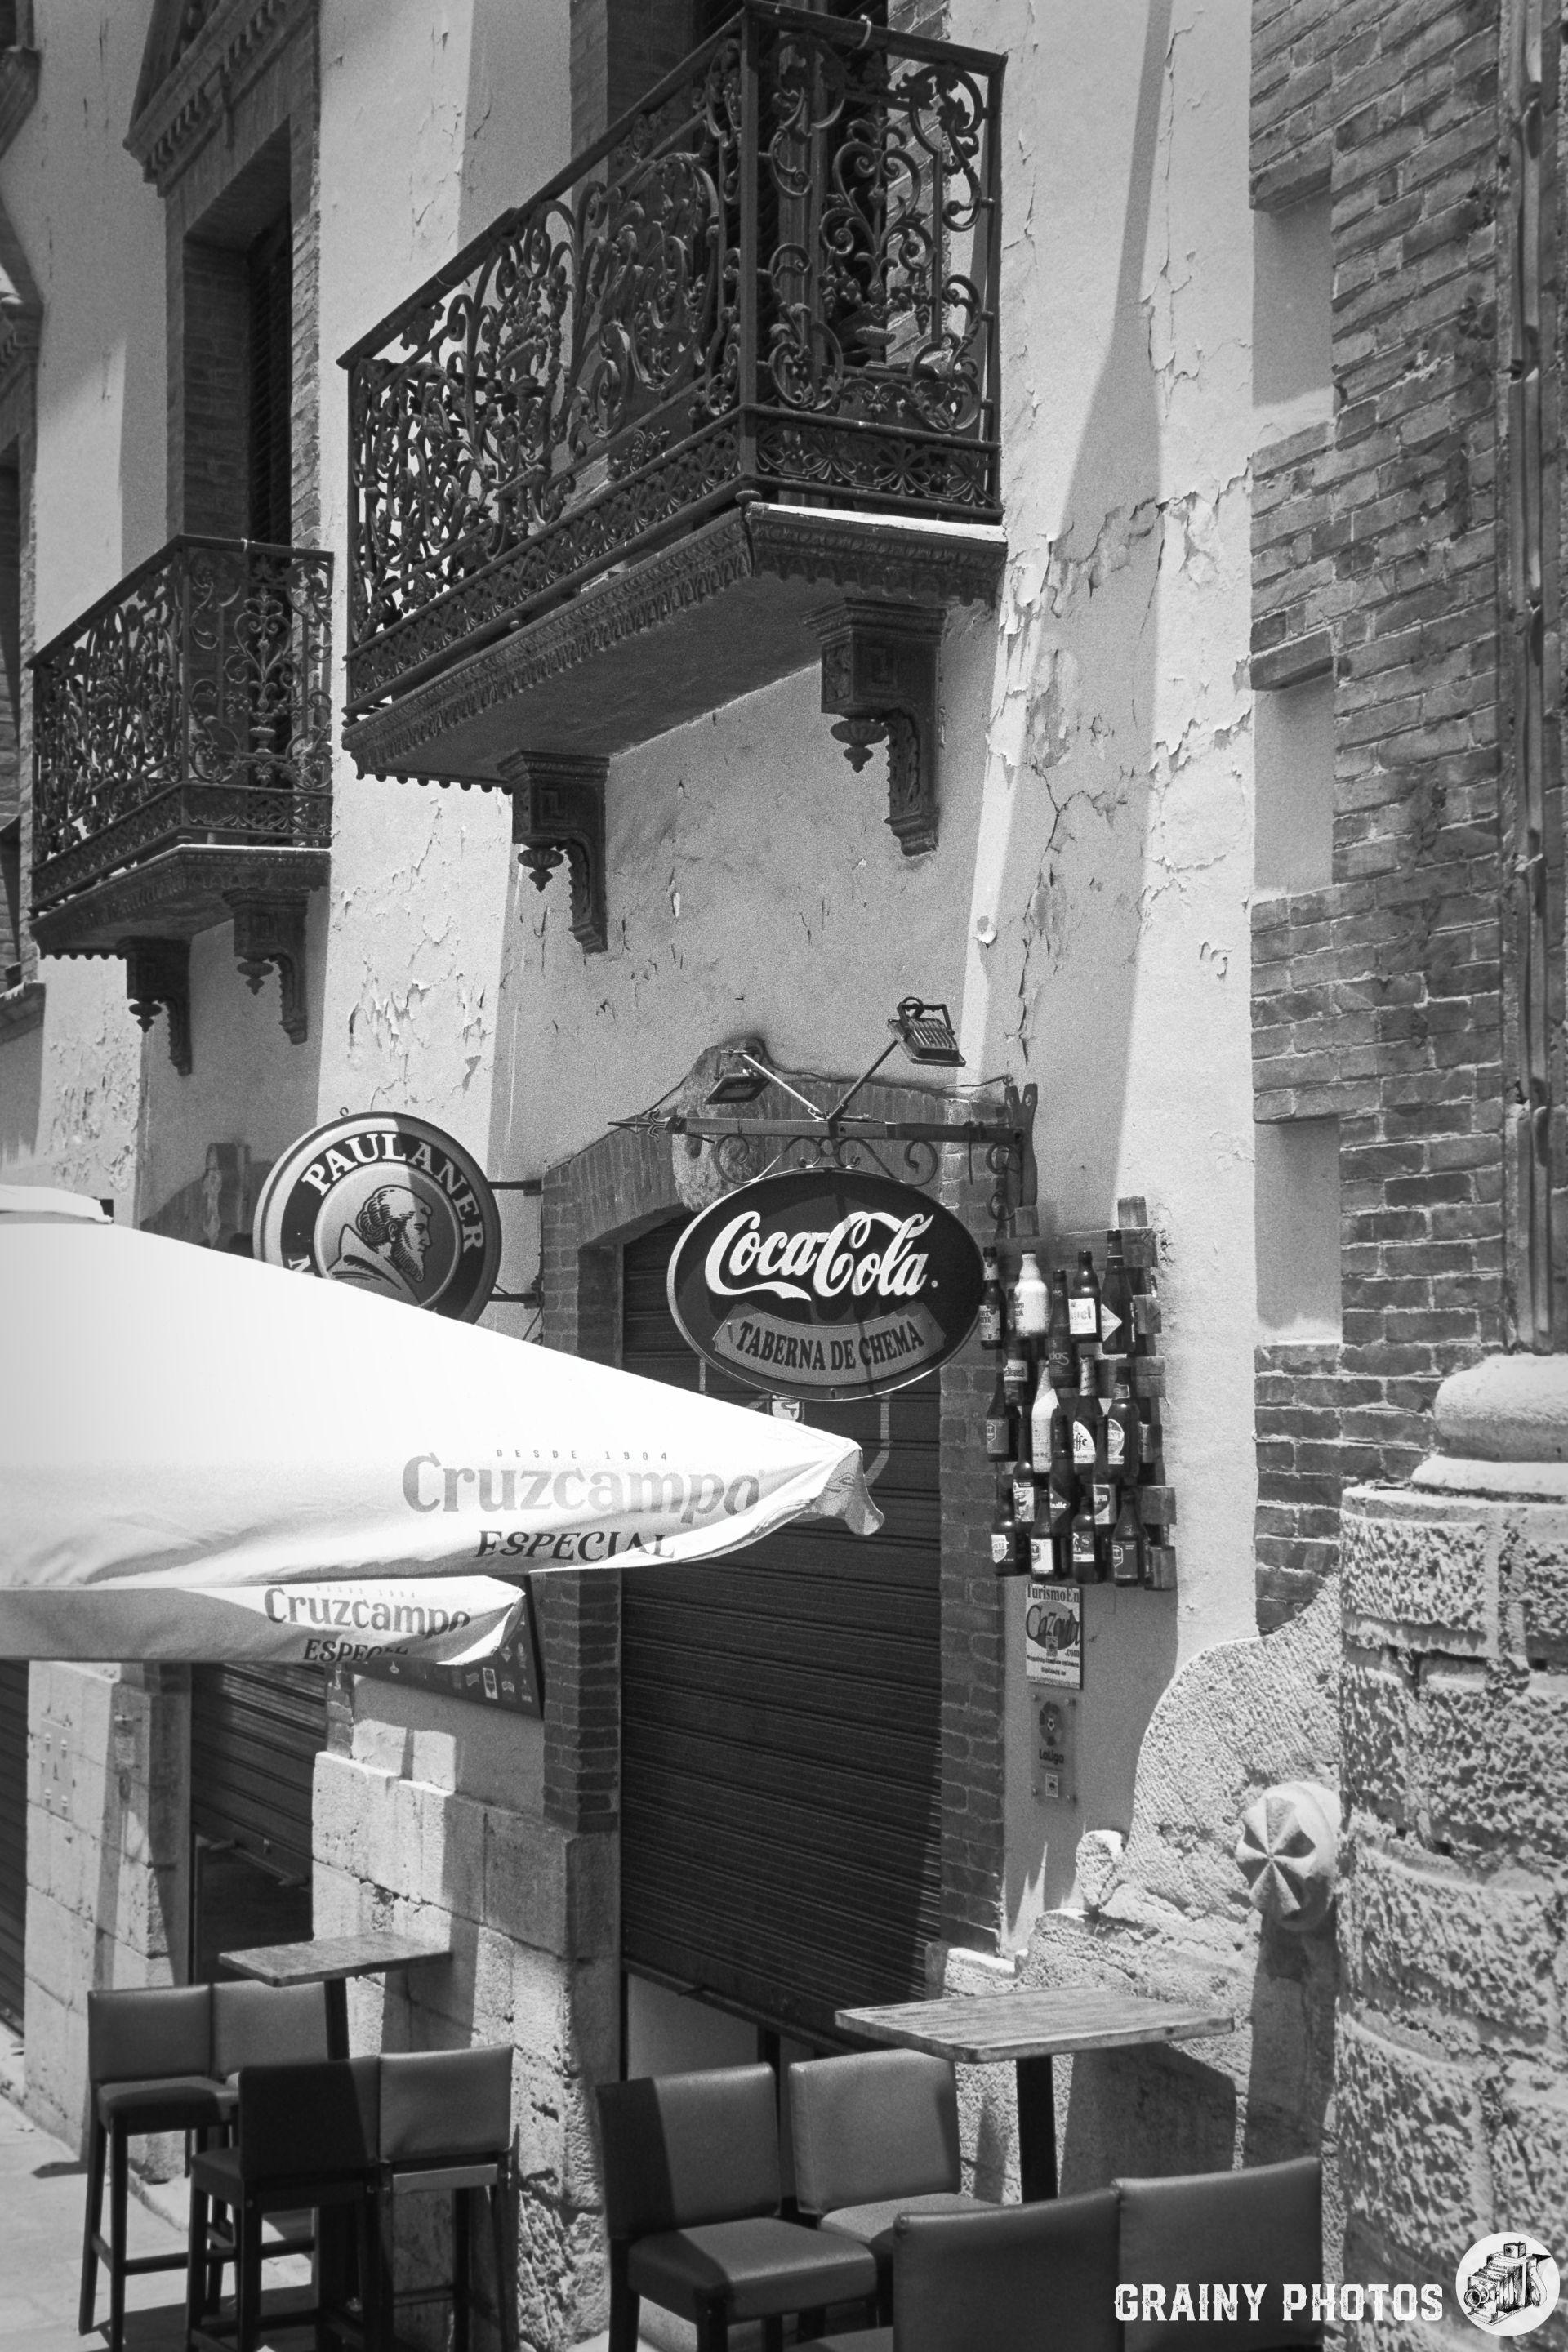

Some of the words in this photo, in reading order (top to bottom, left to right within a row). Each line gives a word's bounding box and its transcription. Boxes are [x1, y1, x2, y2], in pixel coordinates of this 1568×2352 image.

[301, 1133, 484, 1253] PAULANER
[736, 1321, 826, 1370] TABERNA
[830, 1339, 856, 1370] DE
[858, 1321, 924, 1367] CHEMA
[496, 1449, 577, 1459] DESDE
[604, 1450, 668, 1461] 1904
[402, 1452, 760, 1524] Cruzcampo
[474, 1530, 675, 1561] ESPECIAL
[264, 1586, 471, 1641] Cruzcampo
